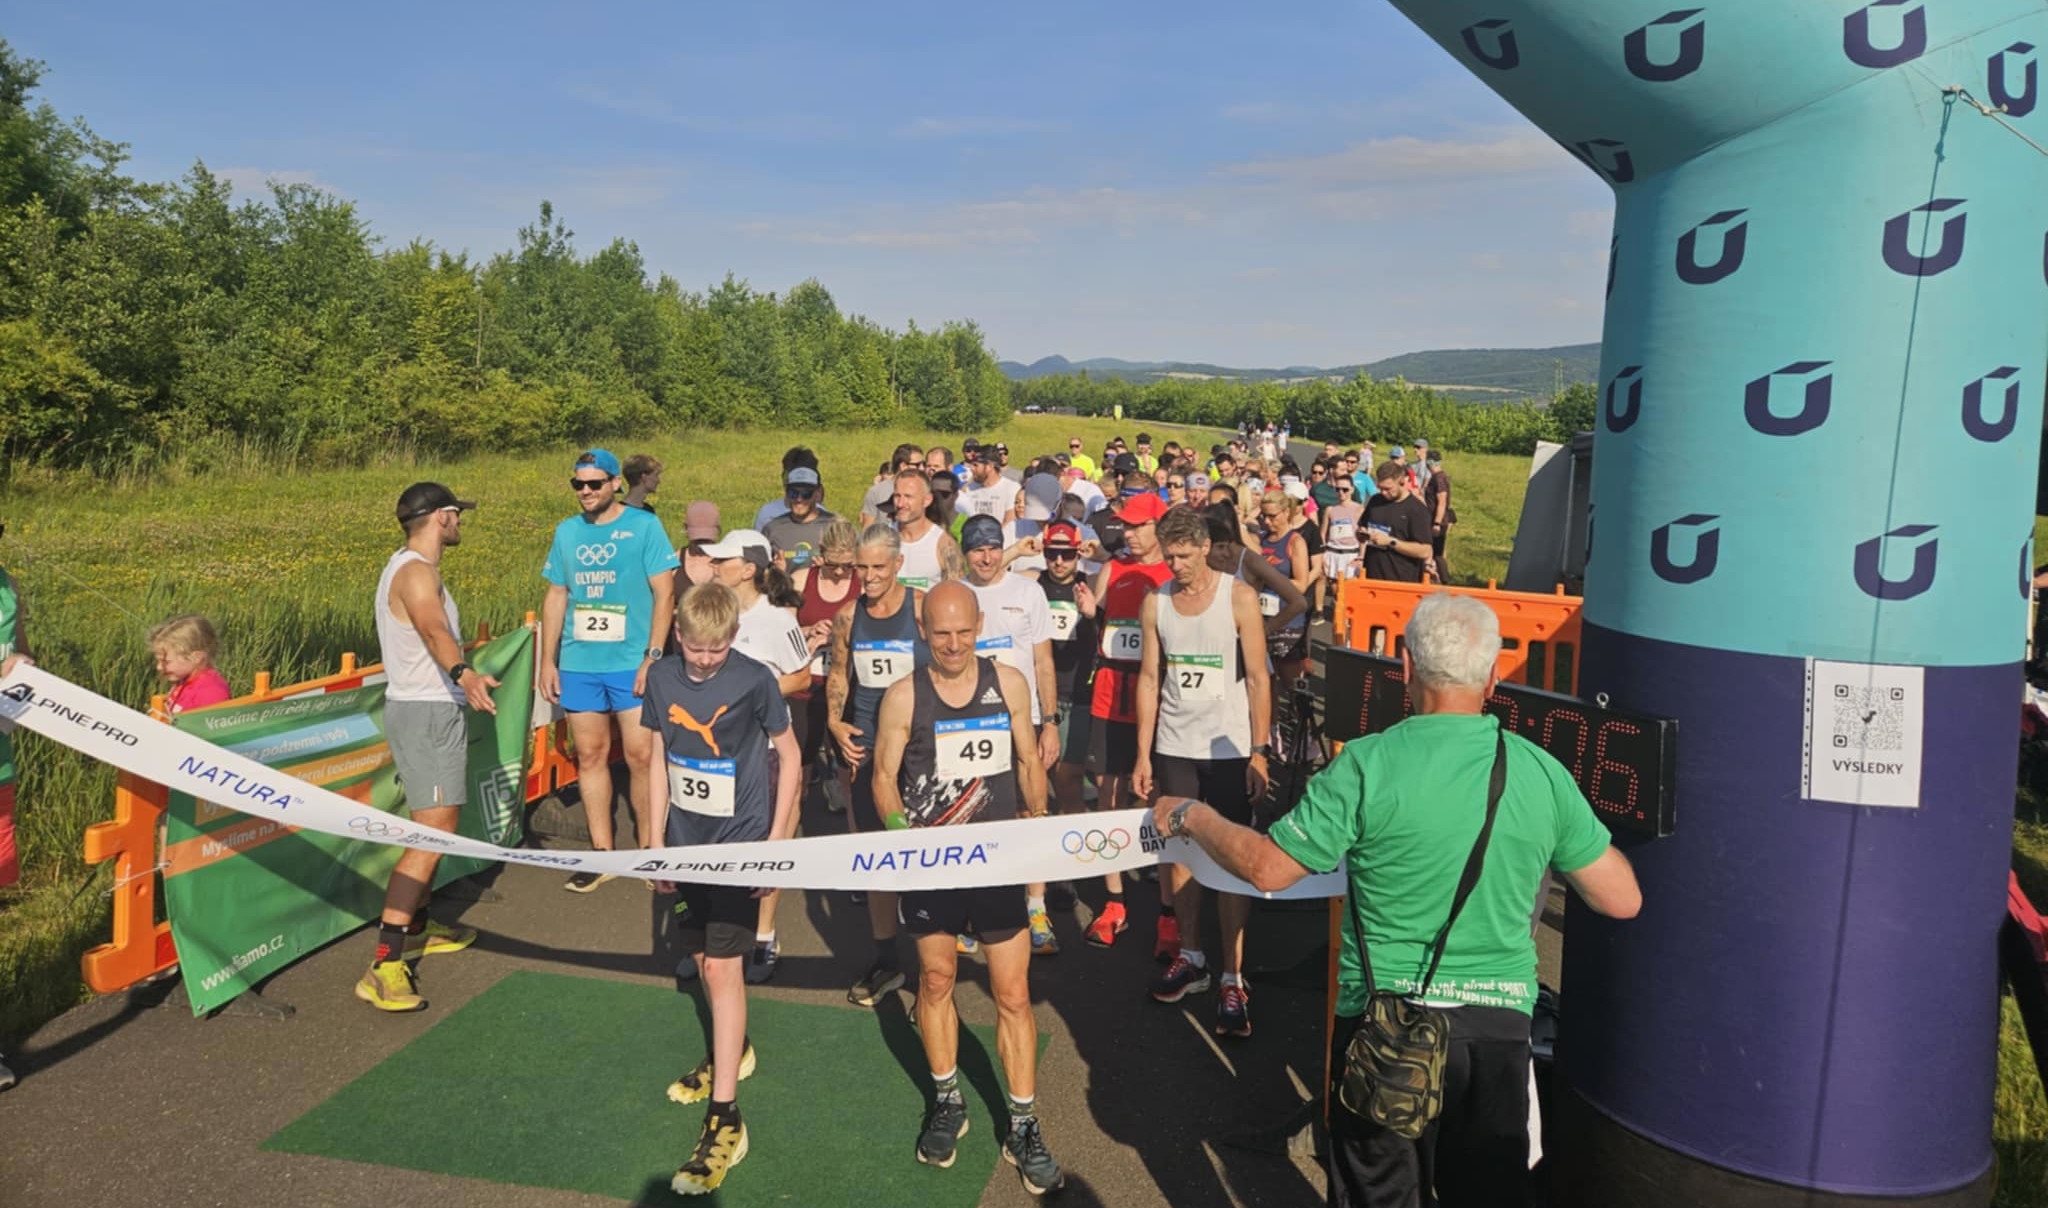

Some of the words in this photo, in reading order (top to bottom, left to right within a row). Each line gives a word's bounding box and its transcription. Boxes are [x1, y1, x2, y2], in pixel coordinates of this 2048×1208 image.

[575, 570, 617, 585] OLYMPIC
[587, 586, 606, 598] DAY
[586, 617, 609, 631] 23
[1052, 615, 1068, 629] 3
[1120, 633, 1140, 649] 16
[872, 659, 892, 675] 51
[1181, 672, 1204, 688] 27
[1, 683, 93, 727] ALPINE
[91, 720, 139, 747] PRO
[260, 731, 322, 760] podzemní
[959, 739, 993, 761] 49
[1832, 758, 1904, 775] VÝSLEDKY
[682, 776, 710, 799] 39
[1142, 838, 1166, 853] DAY
[632, 859, 736, 873] ALPINE
[740, 860, 795, 873] PRO
